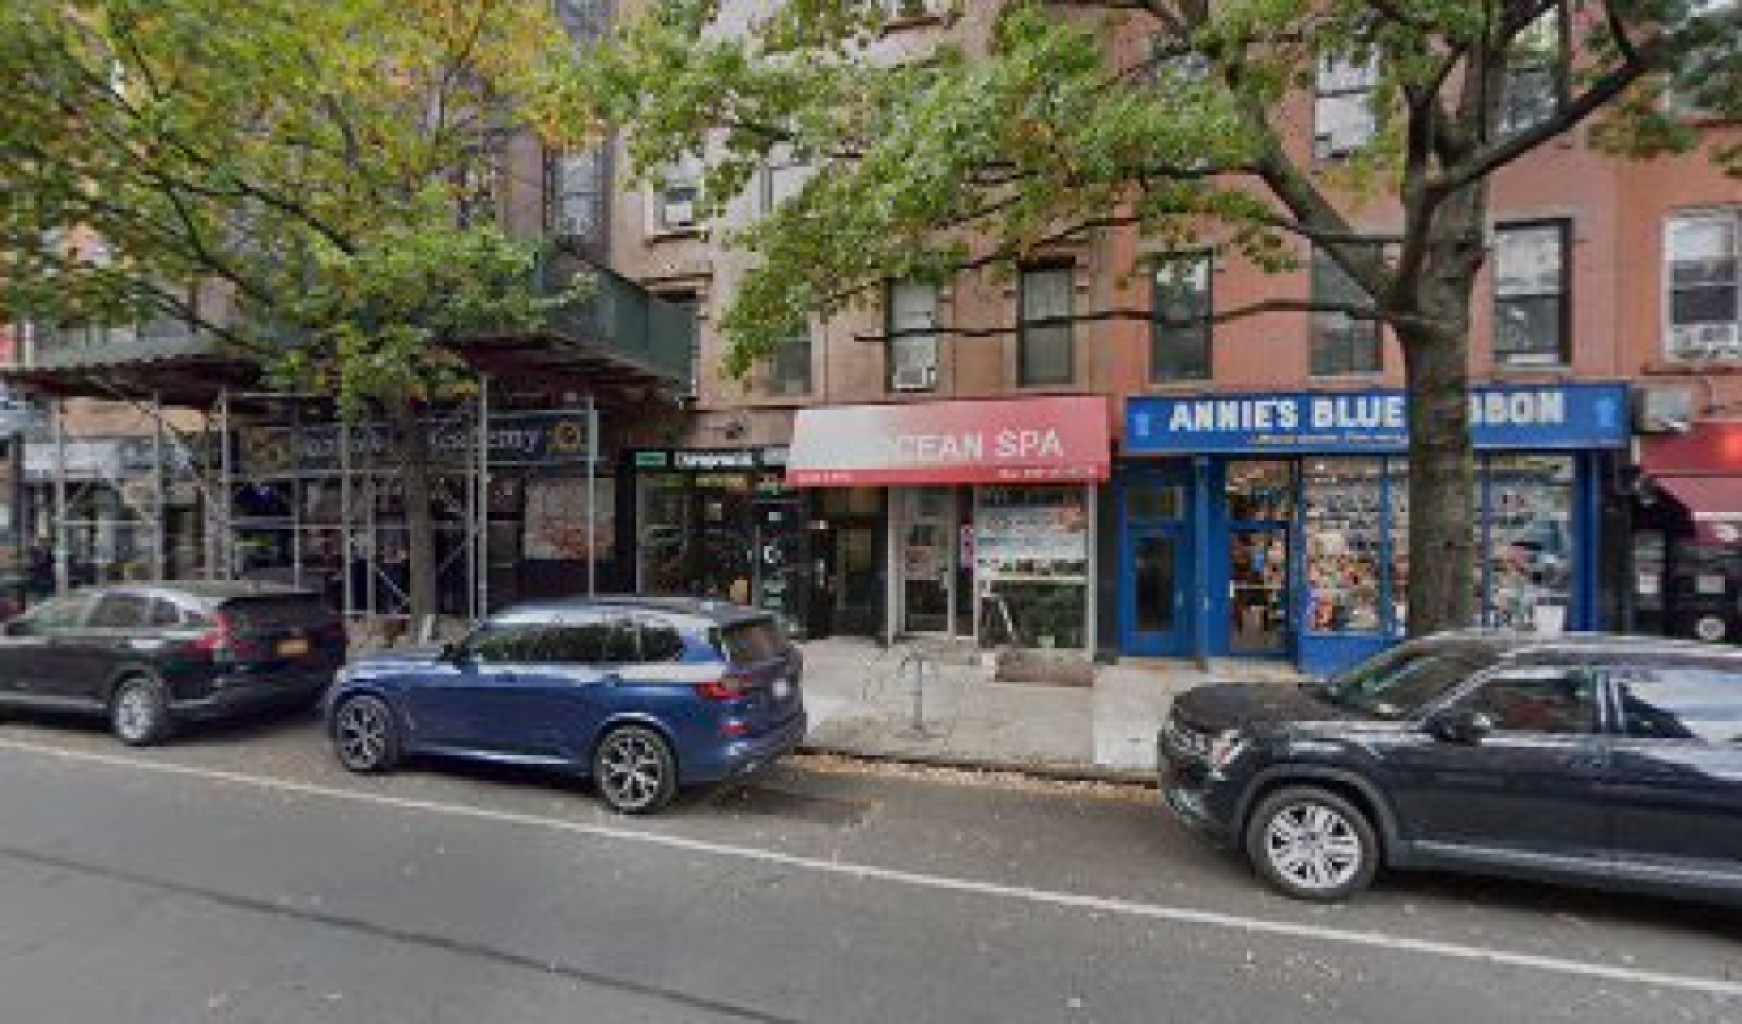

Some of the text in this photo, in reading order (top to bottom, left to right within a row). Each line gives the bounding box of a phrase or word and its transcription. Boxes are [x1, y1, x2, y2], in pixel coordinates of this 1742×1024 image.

[1169, 400, 1298, 431] ANNIE'S
[1311, 395, 1405, 428] BLUE
[888, 427, 1064, 461] CEAN SPA
